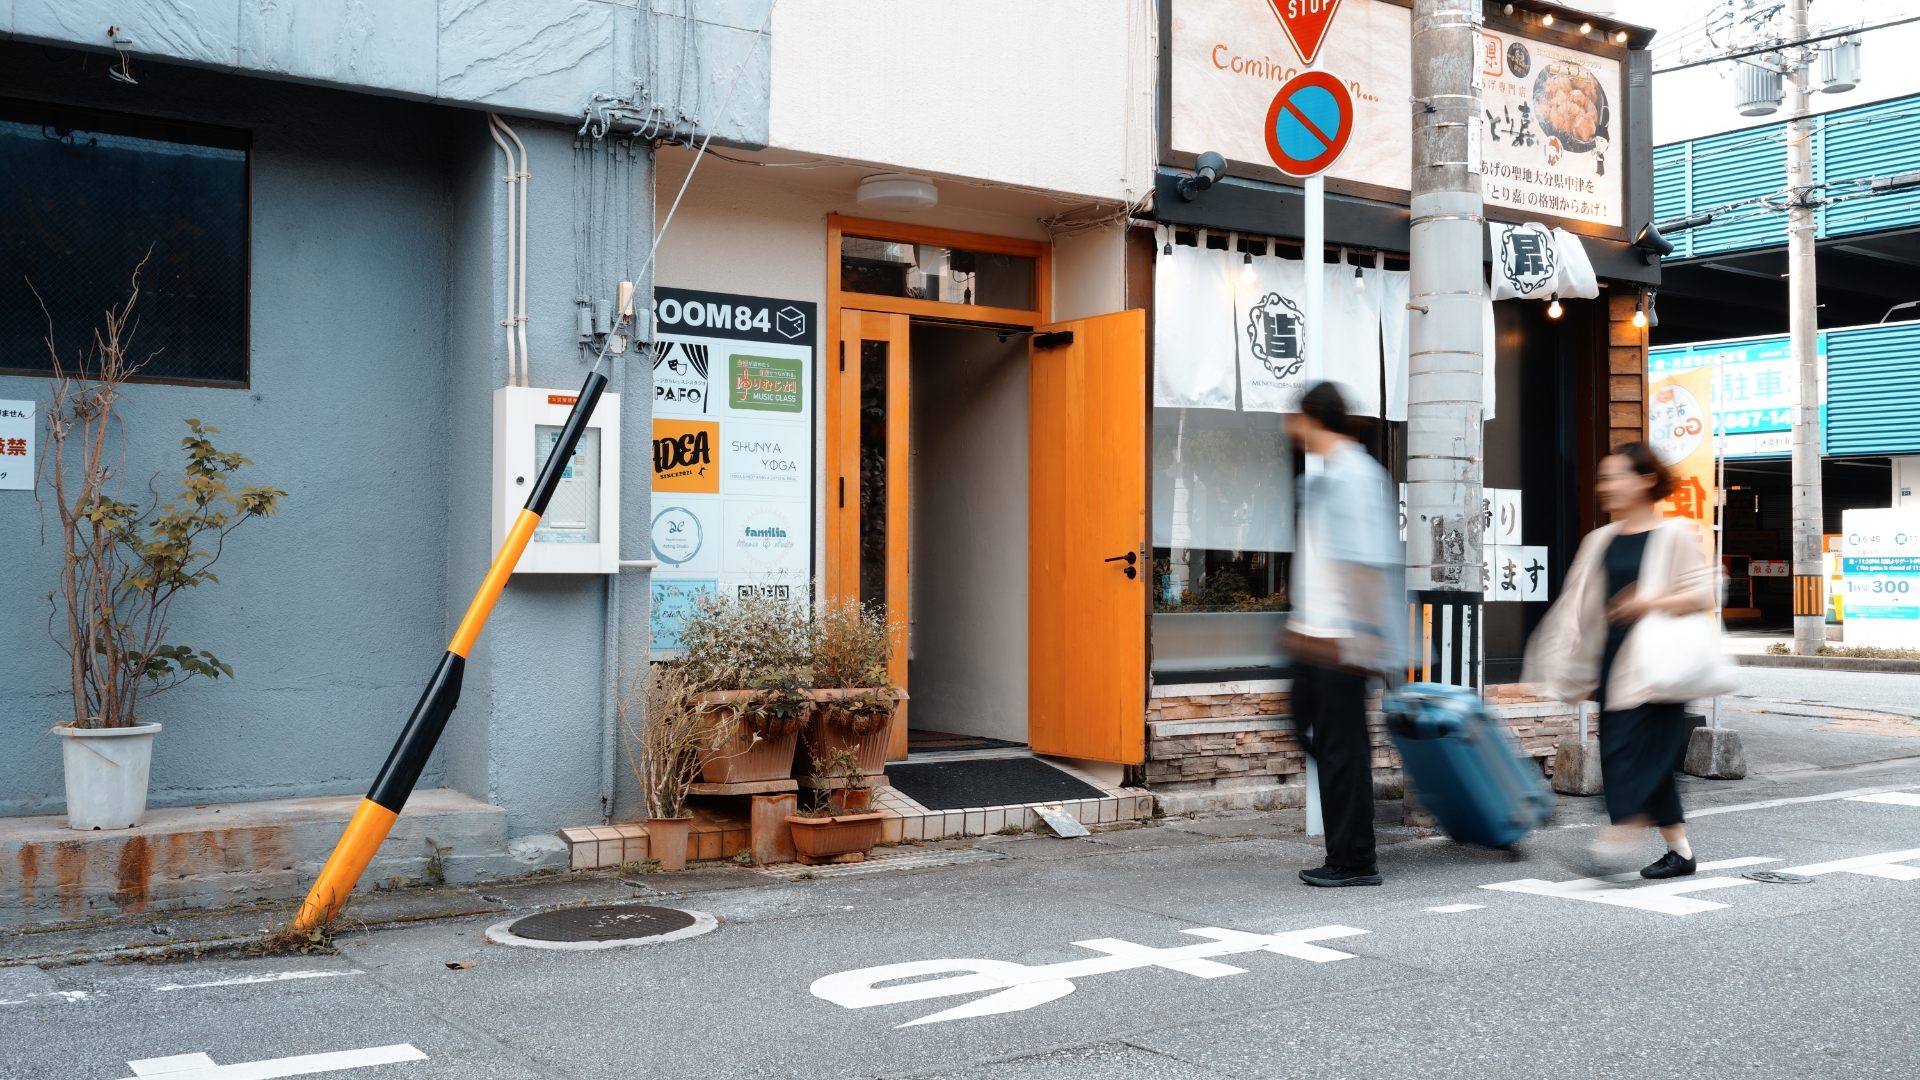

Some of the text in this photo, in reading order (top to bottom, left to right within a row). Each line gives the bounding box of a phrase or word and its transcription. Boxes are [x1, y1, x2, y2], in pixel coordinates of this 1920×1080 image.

[1287, 0, 1331, 19] STOP
[1481, 160, 1595, 195] あげの聖地大分県中津を
[654, 386, 702, 404] PAFO
[753, 393, 797, 403] MUSIC CLASS
[731, 440, 782, 454] SHUNYA
[745, 526, 787, 538] familia
